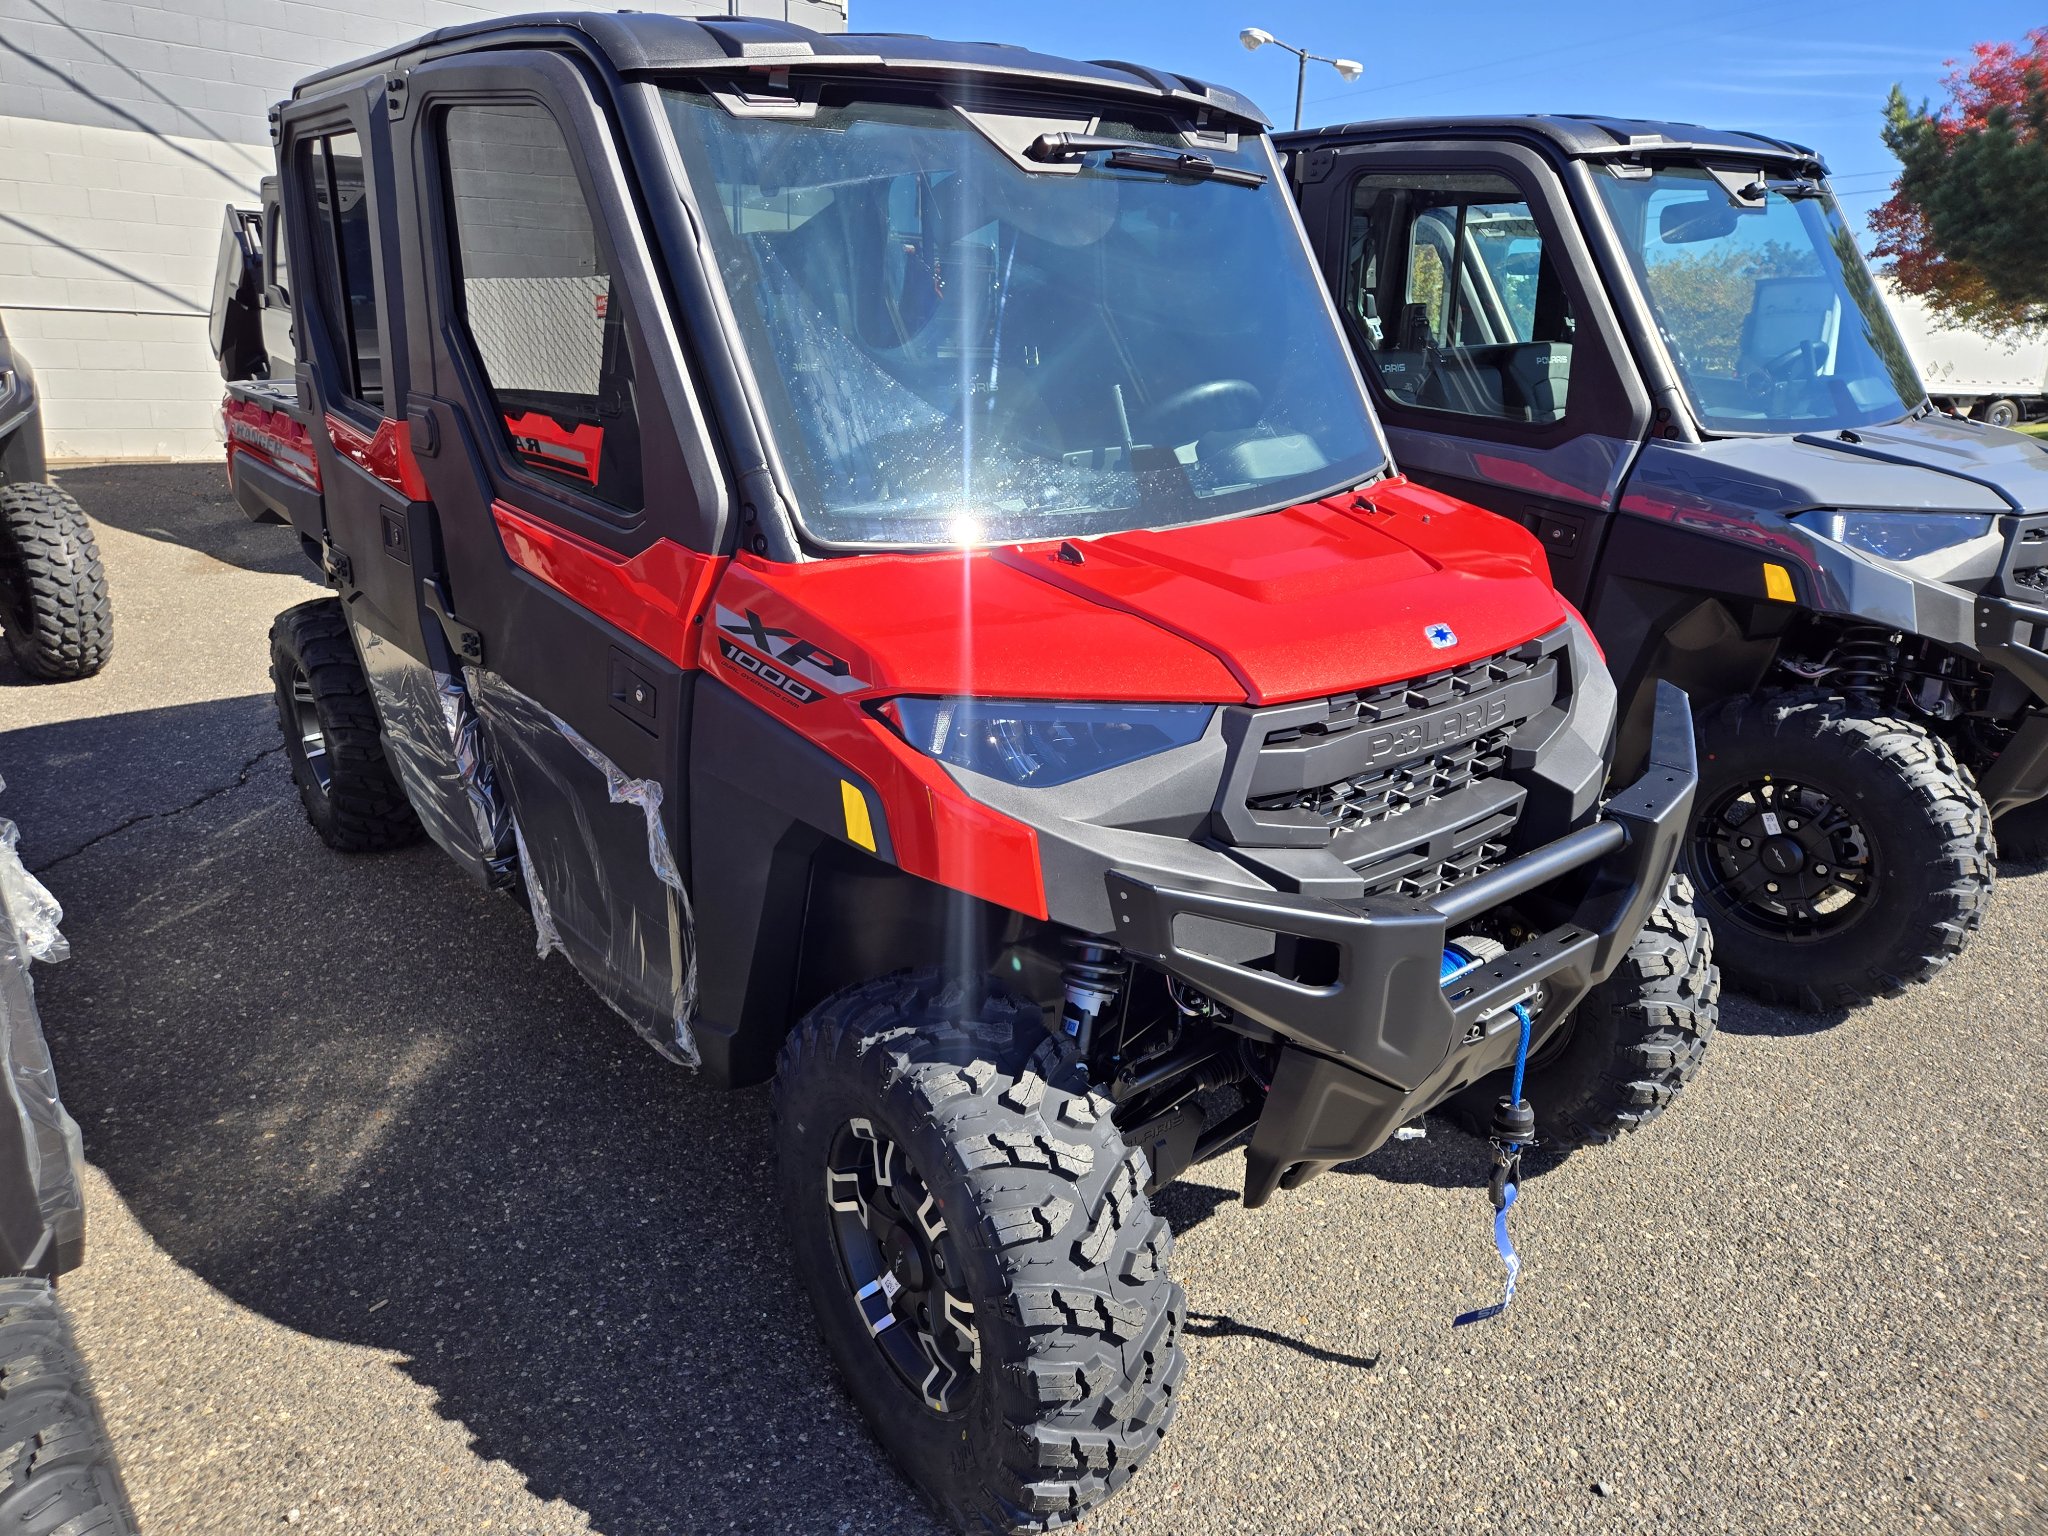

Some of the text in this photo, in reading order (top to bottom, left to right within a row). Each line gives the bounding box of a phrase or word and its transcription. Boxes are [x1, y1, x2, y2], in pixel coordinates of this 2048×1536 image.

[1379, 363, 1406, 373] LARIS
[1536, 355, 1568, 365] POLARIS
[237, 423, 283, 456] RANGER
[720, 608, 851, 676] XP
[727, 645, 812, 701] 1000
[1365, 694, 1507, 765] POLARIS
[1123, 1114, 1185, 1146] LARIS
